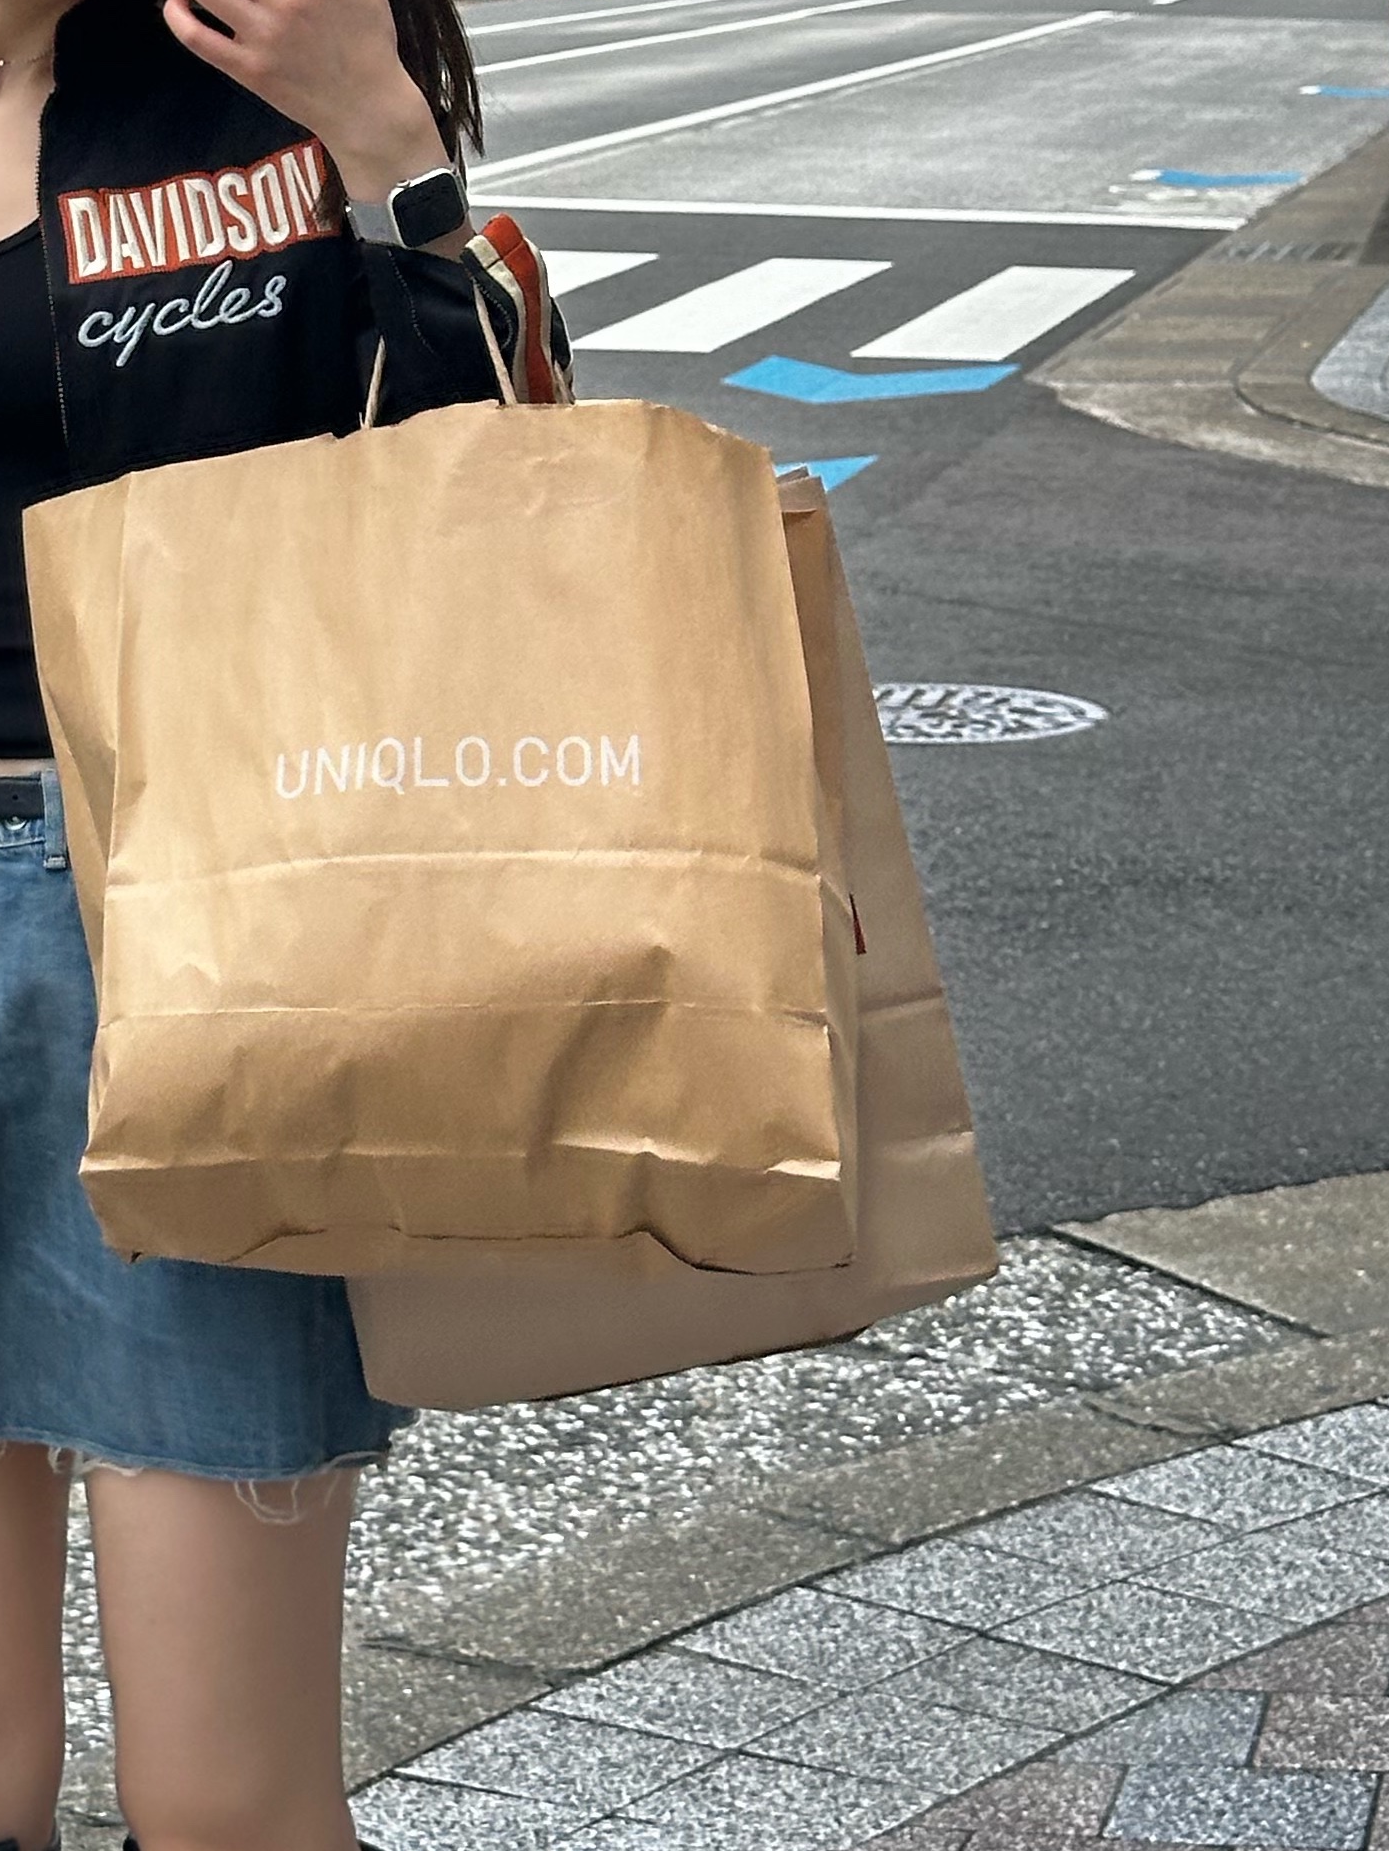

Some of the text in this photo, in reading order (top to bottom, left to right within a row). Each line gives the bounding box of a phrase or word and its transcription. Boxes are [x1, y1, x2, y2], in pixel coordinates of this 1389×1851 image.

[67, 145, 333, 279] DAVIDSON
[76, 259, 288, 368] cycles
[275, 734, 643, 800] UNIQLO.COM
